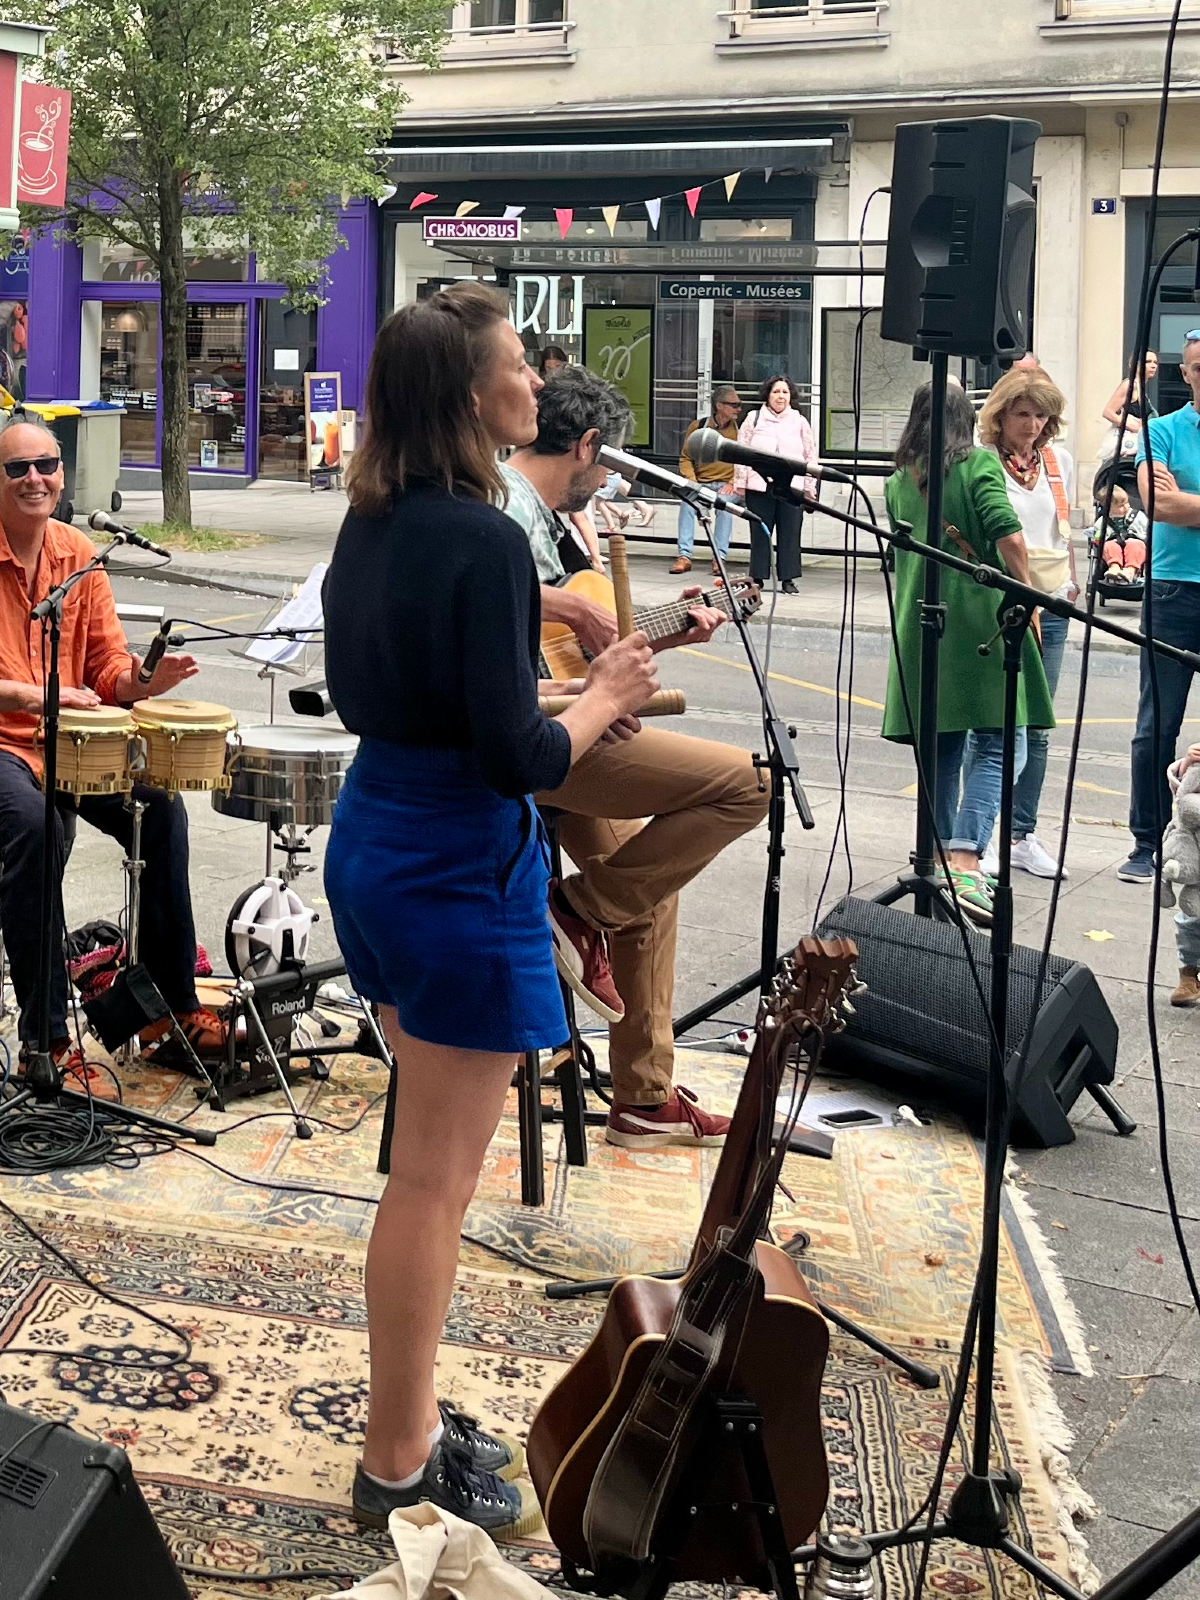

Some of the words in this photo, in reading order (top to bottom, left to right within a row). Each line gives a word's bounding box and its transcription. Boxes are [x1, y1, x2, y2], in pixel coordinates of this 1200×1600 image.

[1100, 200, 1108, 212] 3
[428, 221, 516, 238] CHRONOBUS
[669, 284, 733, 299] Copernic
[746, 284, 802, 299] Musées
[271, 996, 306, 1016] Roland
